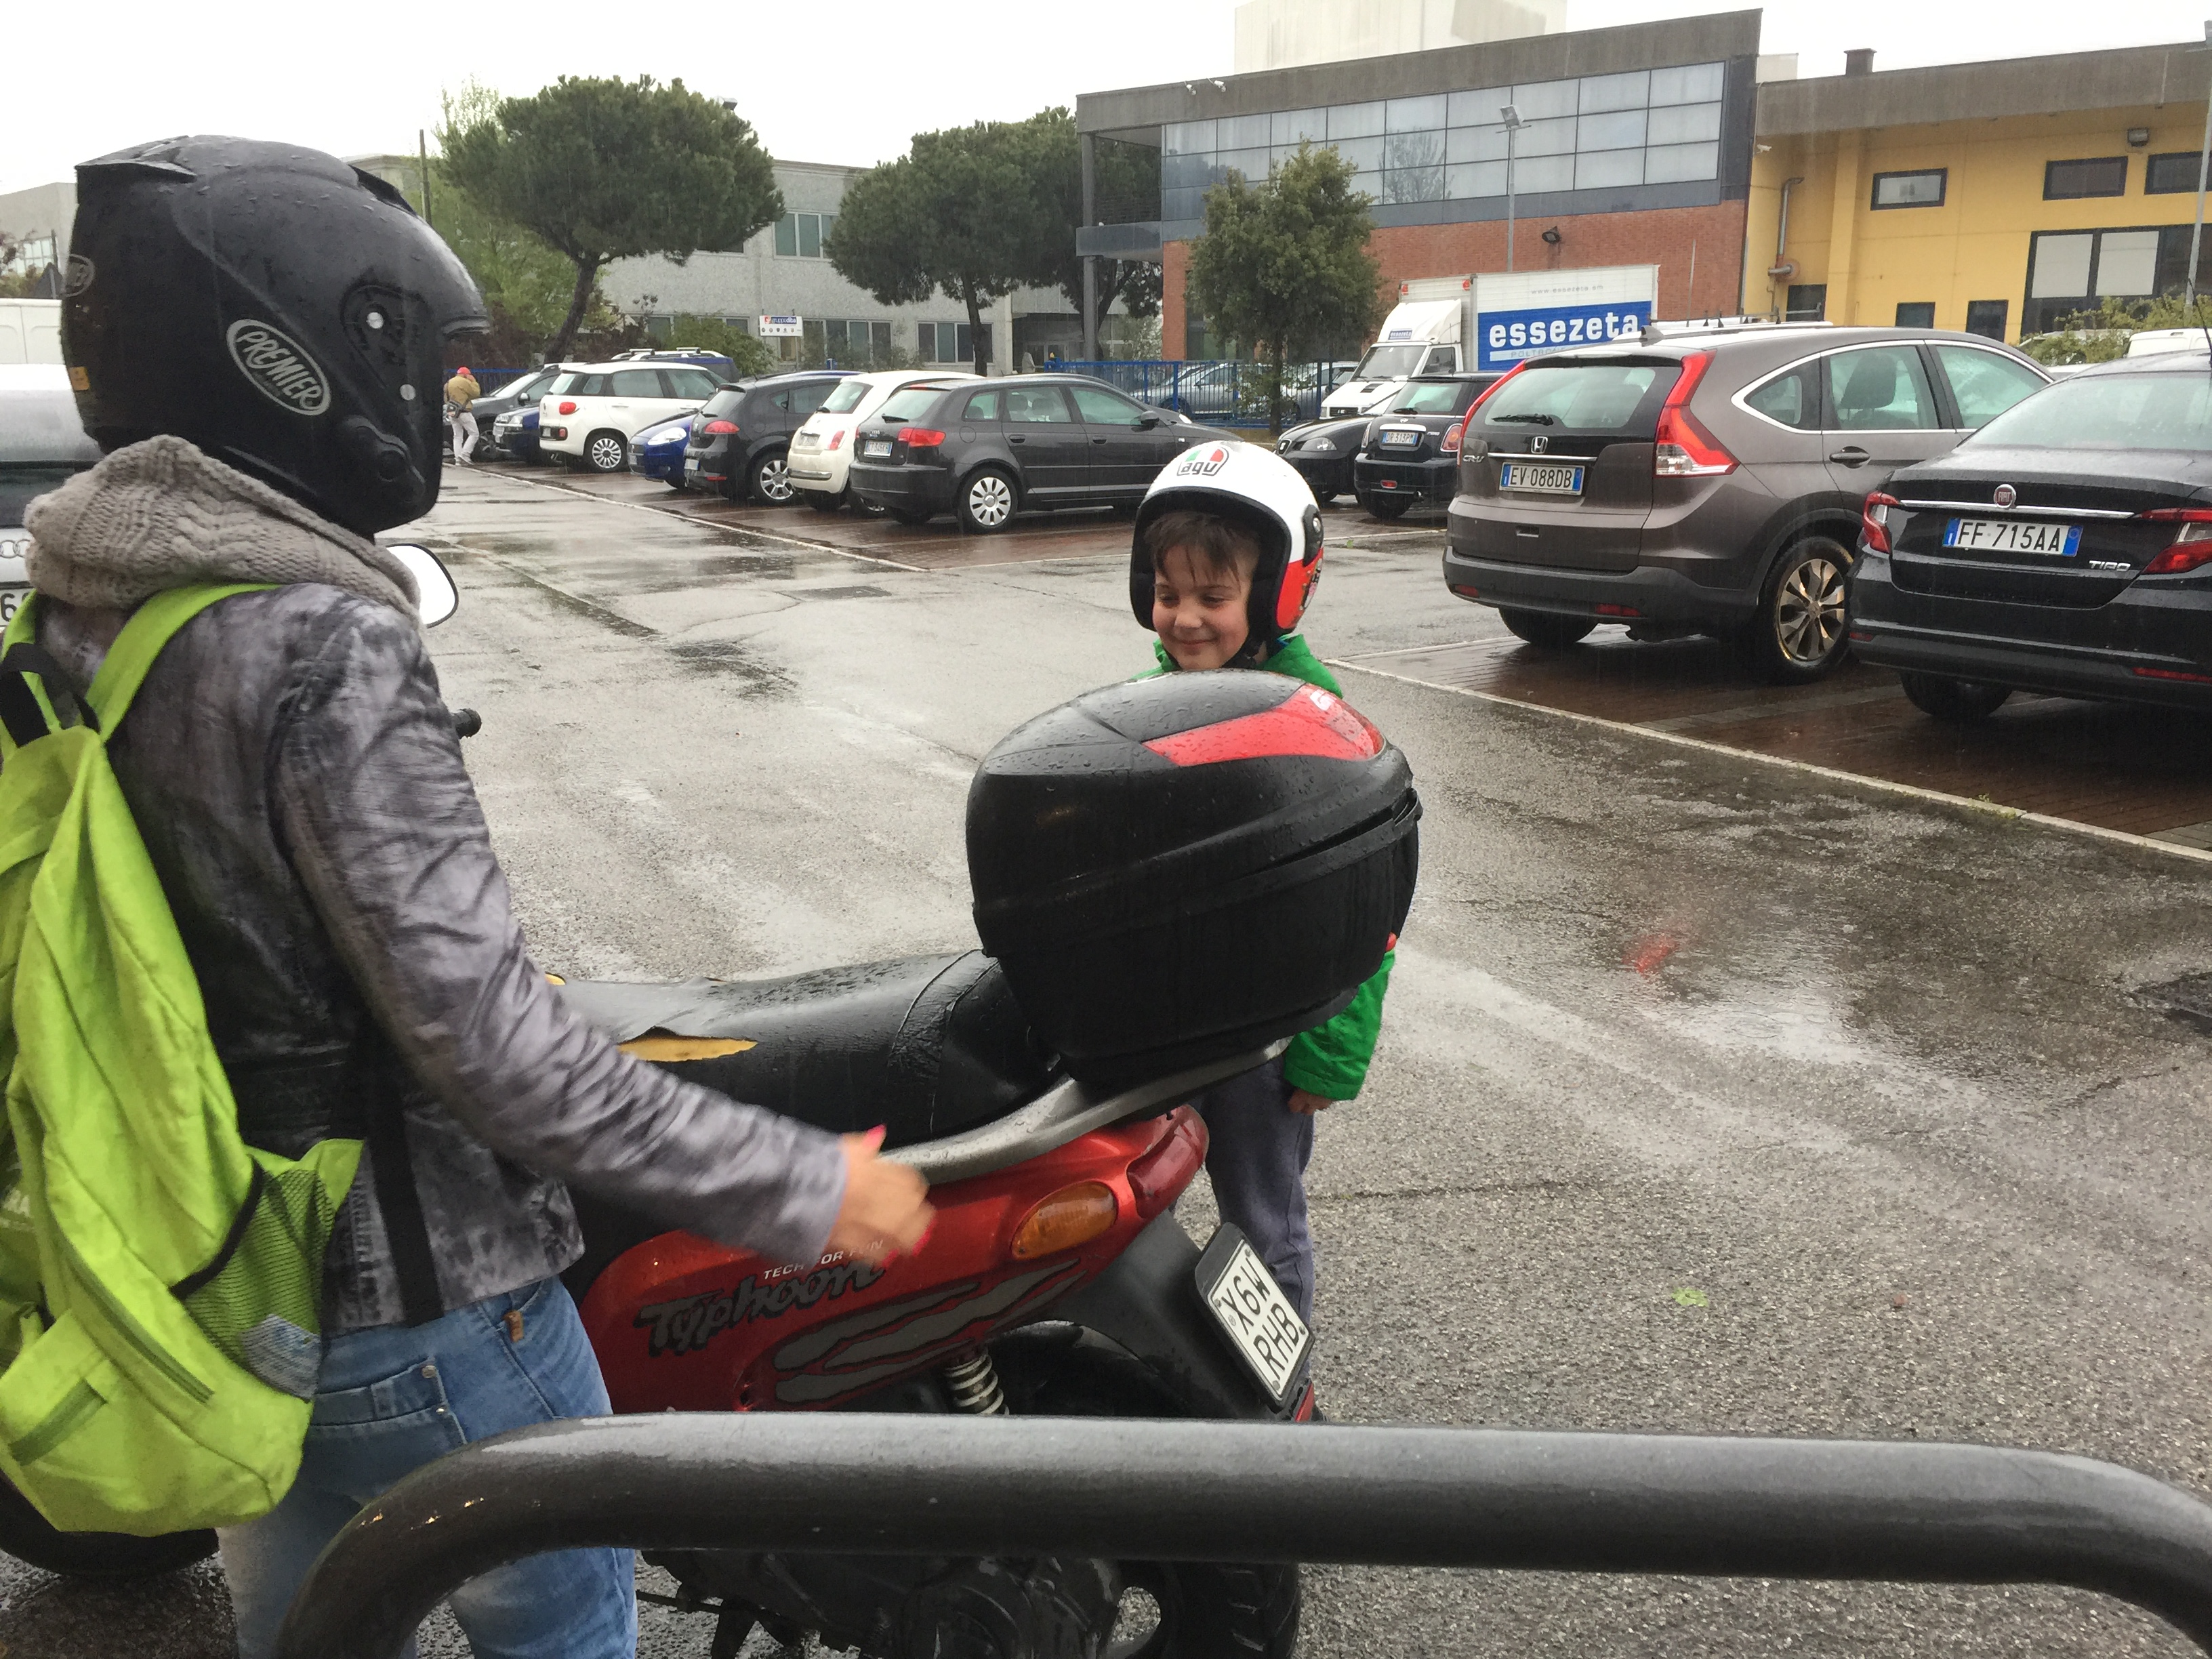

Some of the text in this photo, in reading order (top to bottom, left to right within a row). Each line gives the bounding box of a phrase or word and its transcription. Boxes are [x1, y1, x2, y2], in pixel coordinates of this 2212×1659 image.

[1490, 312, 1639, 348] essezeta
[236, 331, 323, 411] PREMIER
[1510, 467, 1527, 485] EV
[1530, 468, 1572, 488] 088DB
[1998, 491, 2011, 502] FIAT
[1957, 522, 1987, 545] FF
[1992, 523, 2061, 552] 715AA
[2089, 560, 2131, 572] TIPO
[764, 1240, 884, 1279] TECH OR FN
[634, 1259, 885, 1356] Typhoon
[1221, 1257, 1271, 1336] X6W
[1253, 1303, 1300, 1380] RHB
